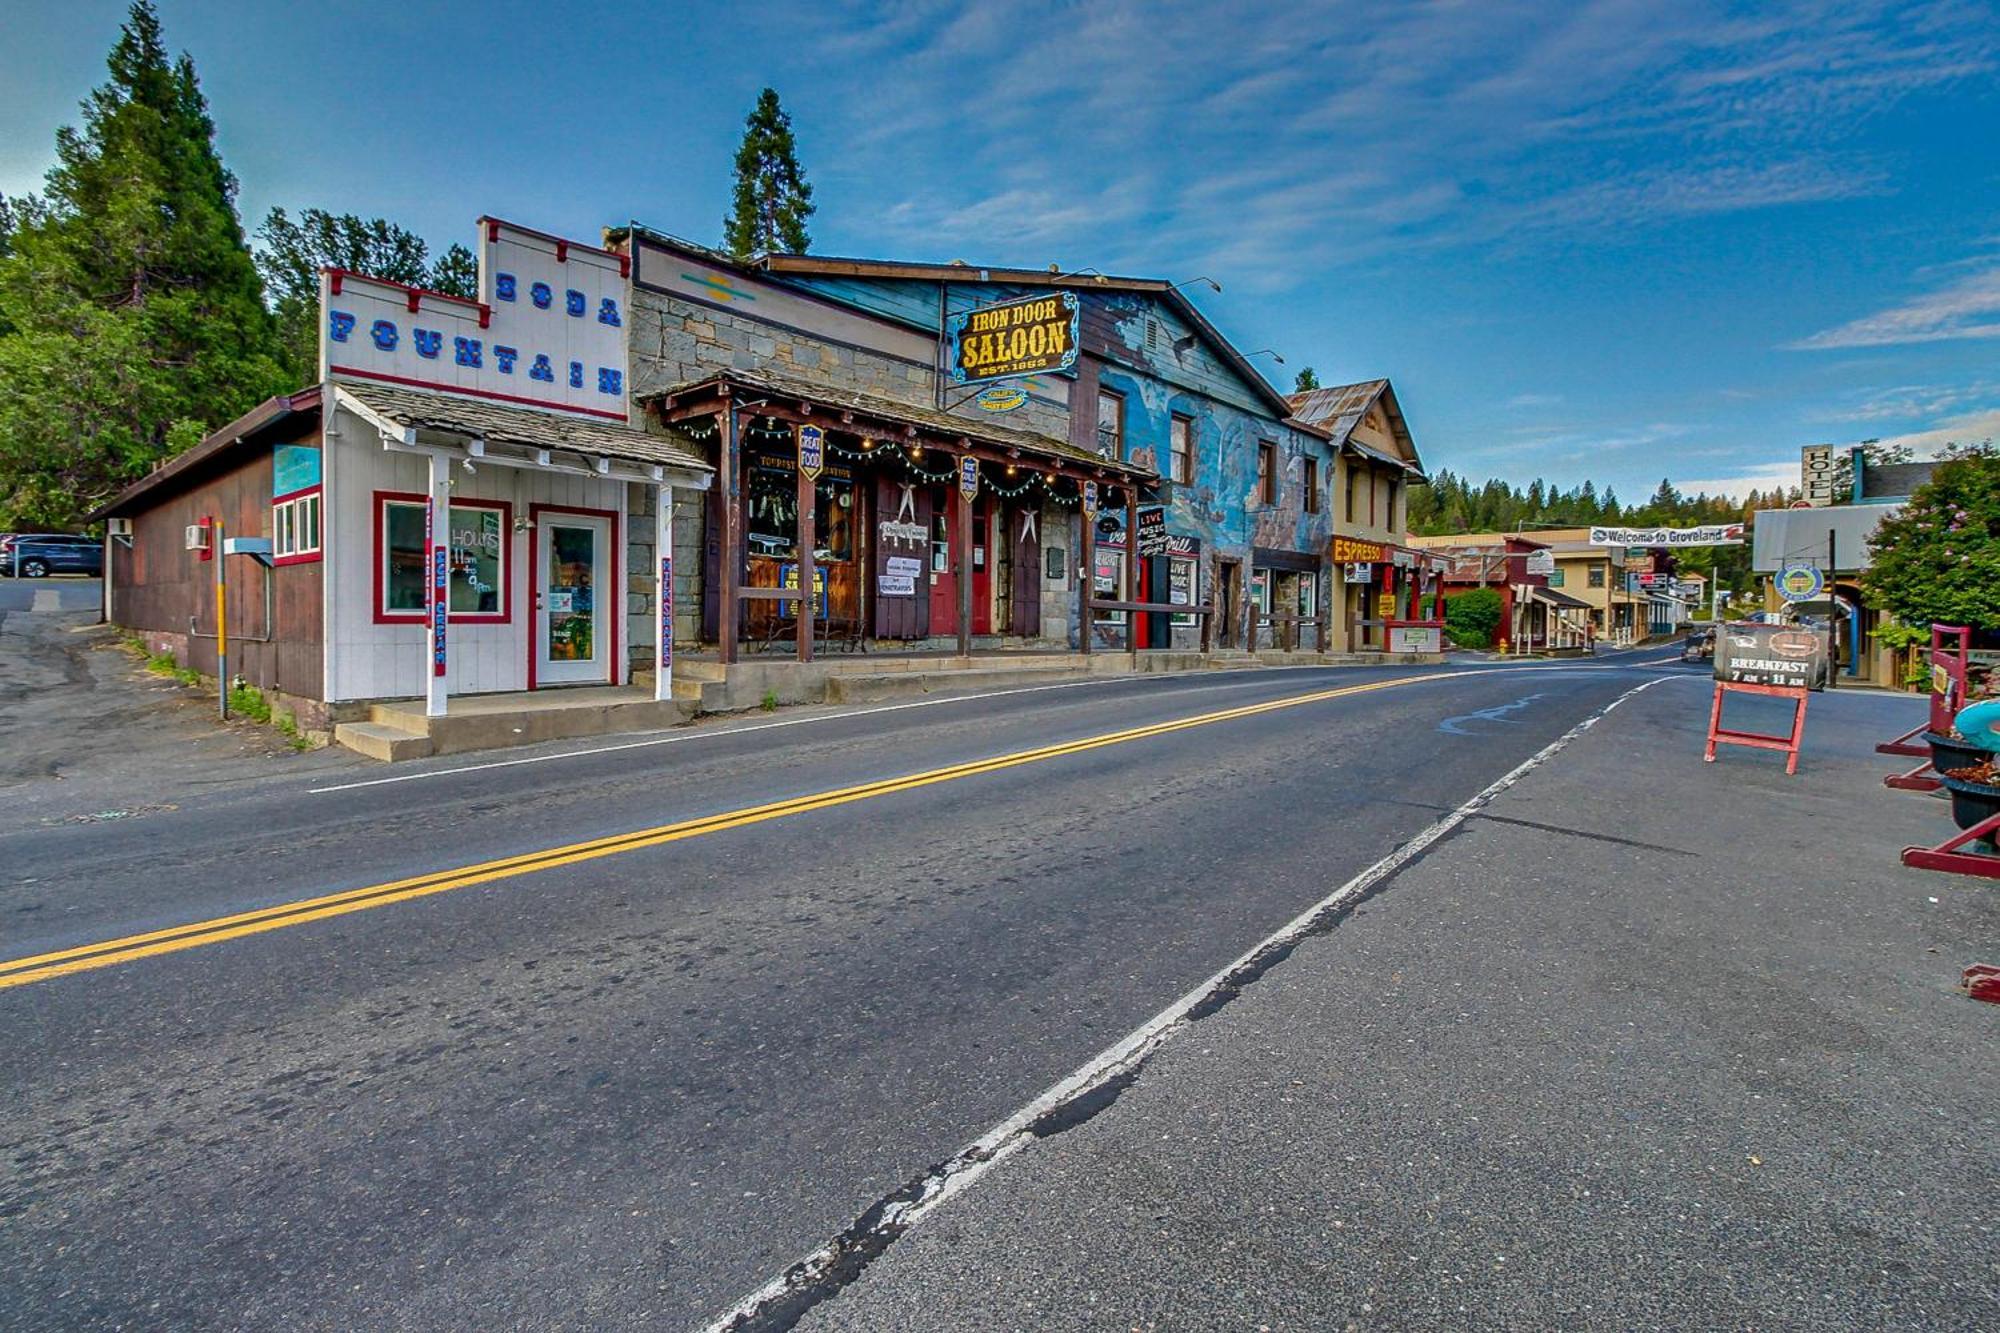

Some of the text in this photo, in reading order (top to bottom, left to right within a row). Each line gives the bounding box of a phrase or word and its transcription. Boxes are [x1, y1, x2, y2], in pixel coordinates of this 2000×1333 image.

[496, 272, 621, 327] SODA
[972, 300, 1056, 333] IRON DOOR
[330, 310, 622, 396] FOUNTAIN
[963, 320, 1066, 368] SALOON
[801, 435, 821, 450] GREAT
[801, 451, 821, 467] FOOD
[1809, 452, 1830, 499] HOTEL
[1141, 513, 1162, 525] LIVE
[1608, 527, 1722, 543] Welcome to Groveland
[1335, 540, 1380, 560] ESPRESSO
[1730, 658, 1808, 672] BREAKFAST
[1732, 671, 1740, 680] 7
[1772, 674, 1784, 684] 11
